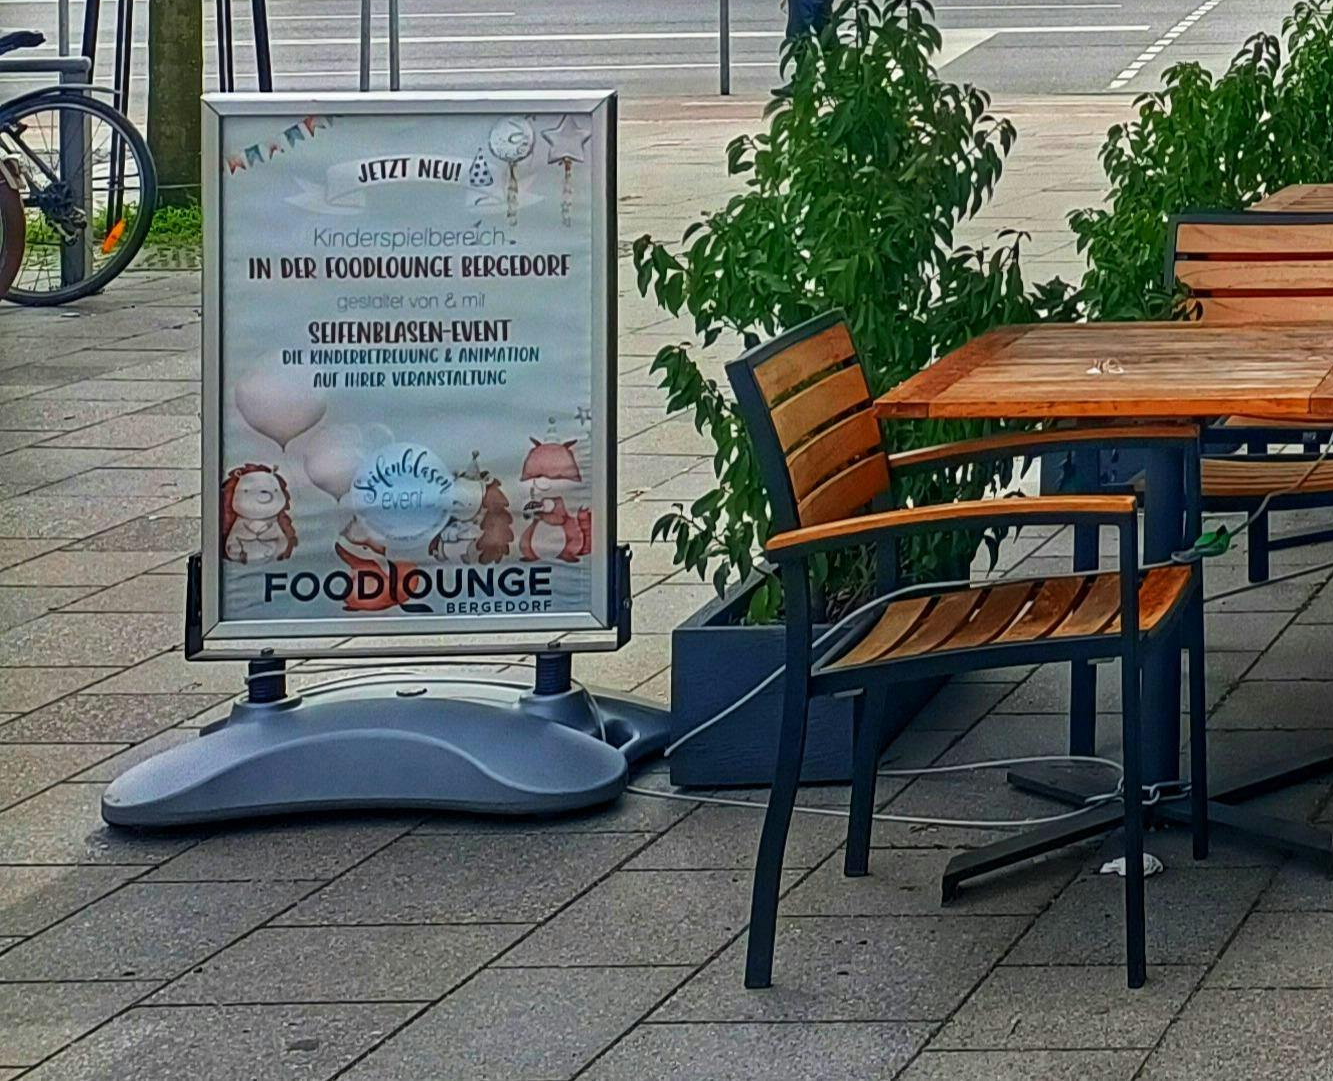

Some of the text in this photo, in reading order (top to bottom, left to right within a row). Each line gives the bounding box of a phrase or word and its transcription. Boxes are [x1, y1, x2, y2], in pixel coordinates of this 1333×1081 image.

[358, 158, 462, 183] JETZT NEU!
[313, 227, 505, 252] Kinderspielbereich
[249, 254, 572, 280] IN DER FOODLOUNGE BERGEDORF
[336, 293, 486, 312] gestaltet von & mit
[308, 319, 513, 345] SEIFENBLASEN-EVENT
[281, 346, 541, 366] DIE KINDERBETREUUNG & ANIMATION
[313, 369, 507, 389] AUF IHRER VERANSTALTUNG
[354, 448, 452, 504] Seifenblasen
[382, 490, 423, 510] event
[446, 600, 552, 614] BERGEDORF
